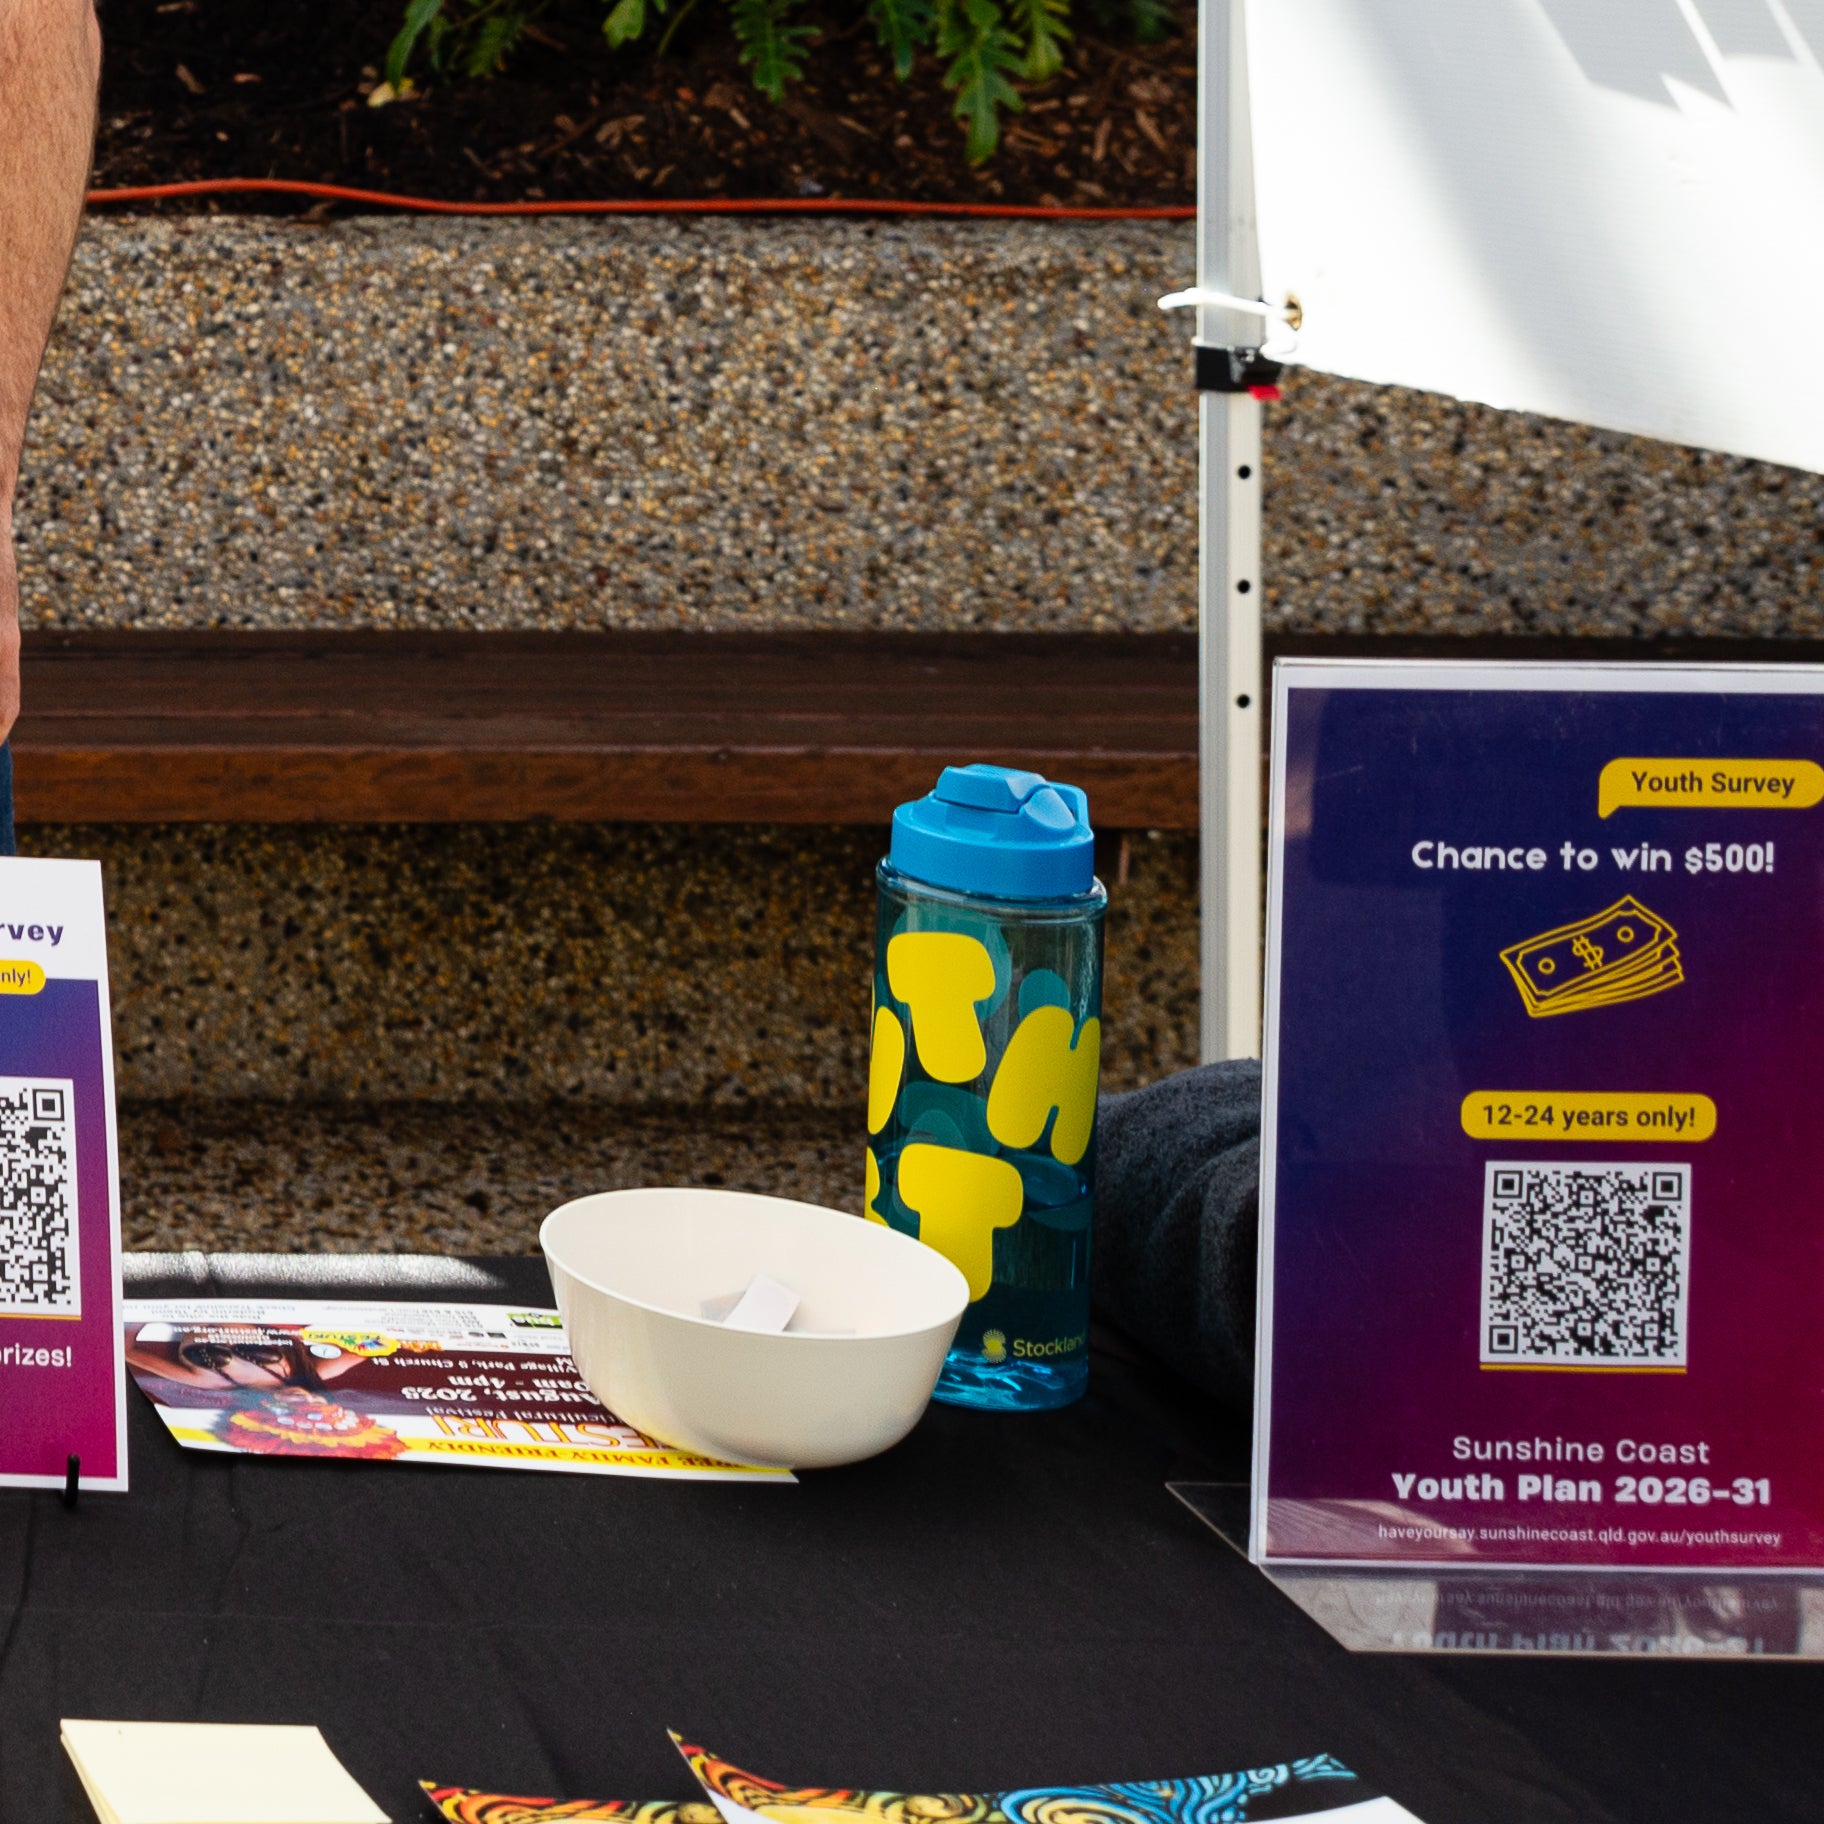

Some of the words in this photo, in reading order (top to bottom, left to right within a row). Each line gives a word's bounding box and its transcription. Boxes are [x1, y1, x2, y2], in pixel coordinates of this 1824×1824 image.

[1631, 770, 1703, 793] Youth
[1711, 772, 1795, 799] Survey
[1411, 840, 1548, 870] Chance
[1559, 841, 1599, 871] to
[1611, 842, 1672, 872] win
[1684, 842, 1774, 874] $500!
[1483, 1104, 1555, 1126] 12-24
[1562, 1110, 1629, 1132] years
[1636, 1105, 1695, 1133] only!
[1453, 1436, 1604, 1462] Sunshine
[1616, 1439, 1709, 1465] Coast
[1390, 1473, 1505, 1501] Youth
[1518, 1474, 1601, 1502] Plan
[1614, 1476, 1770, 1505] 2026-31
[1378, 1522, 1781, 1547] haveyoursay.sunshinecoast.qld.gov.au/youthsurvey
